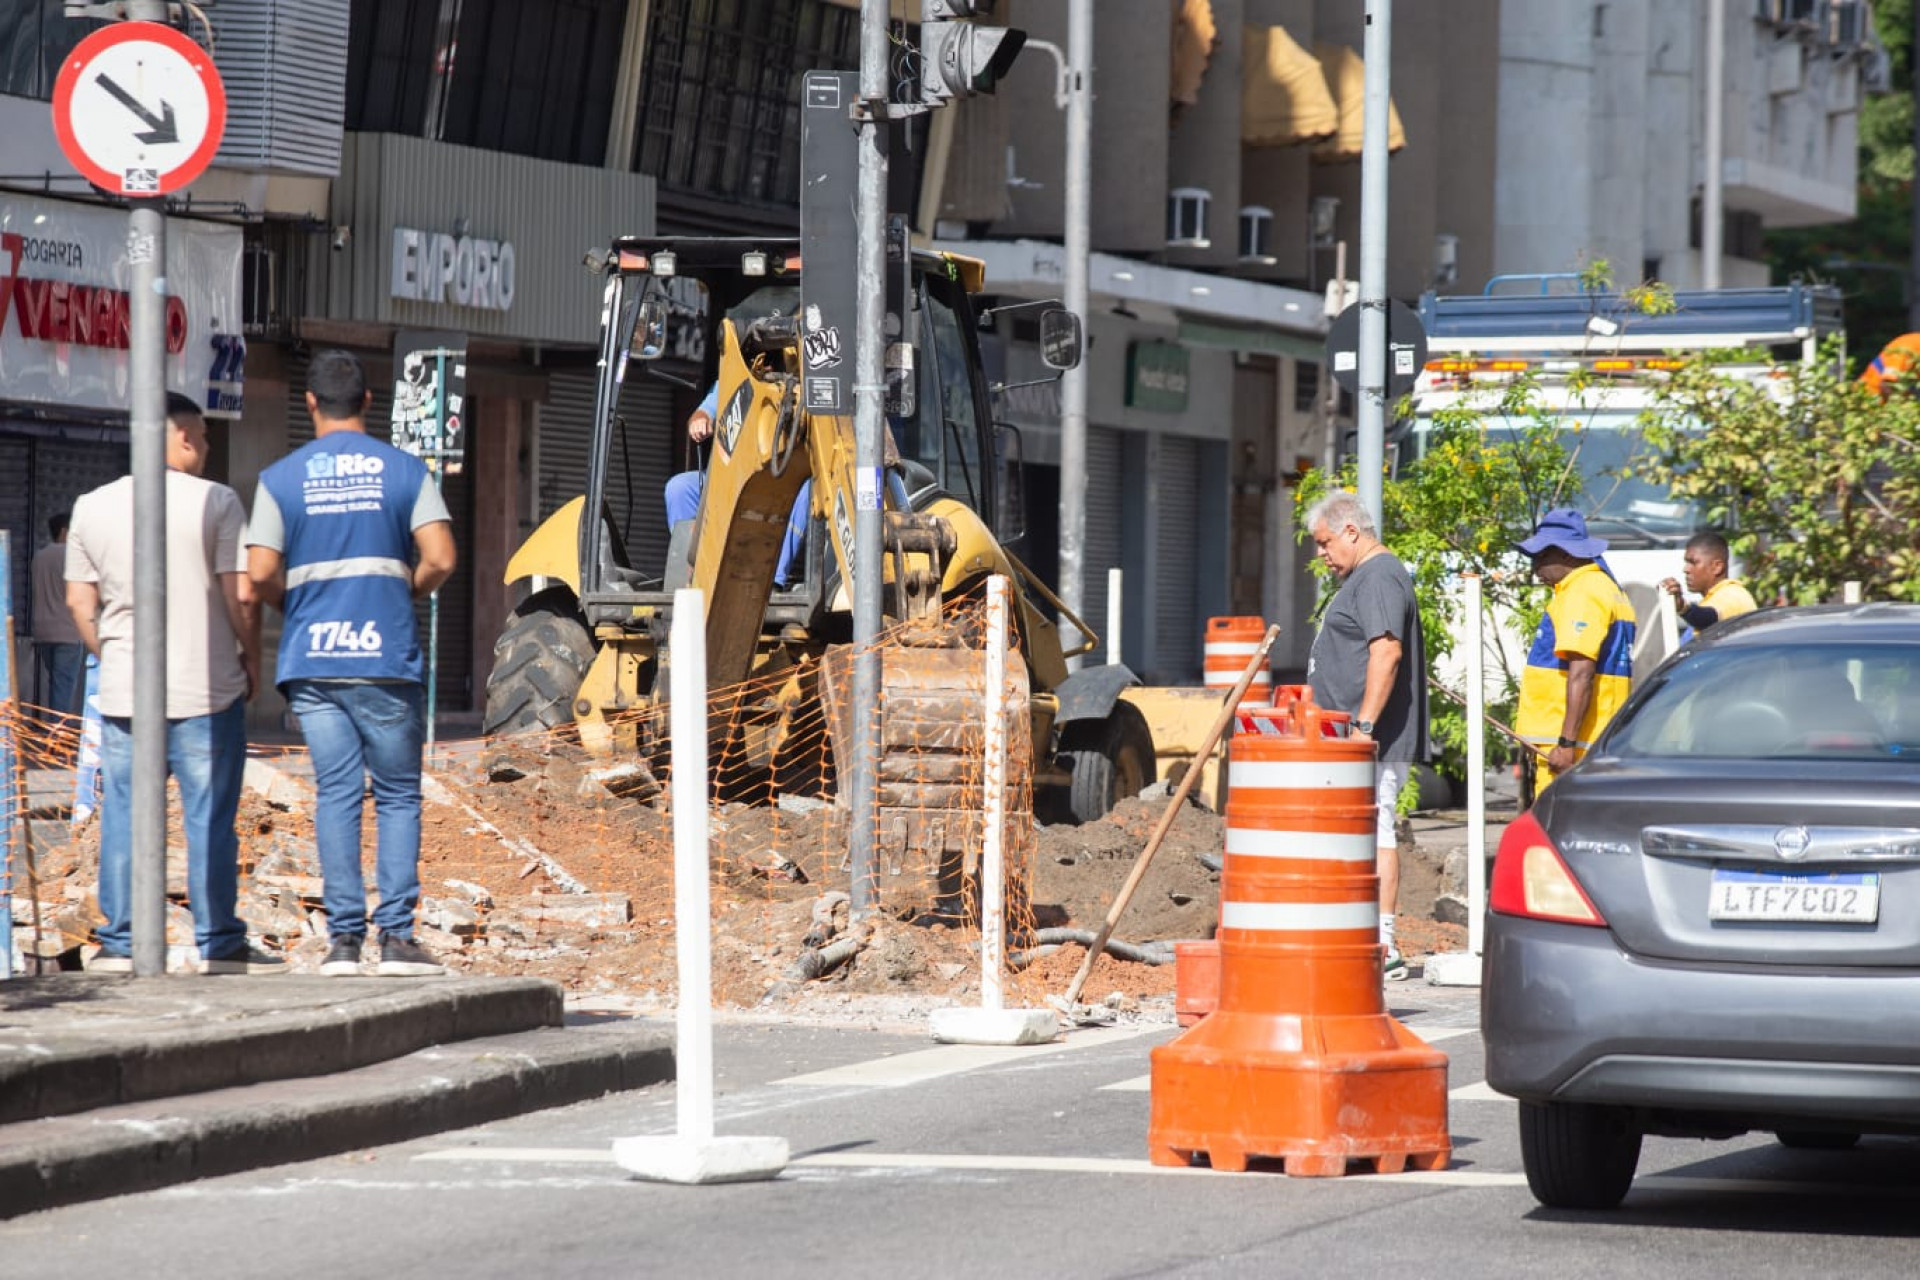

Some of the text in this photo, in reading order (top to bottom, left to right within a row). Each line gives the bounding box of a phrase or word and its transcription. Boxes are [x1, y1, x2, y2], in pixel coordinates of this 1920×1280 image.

[15, 277, 188, 355] VENANO
[336, 453, 384, 477] Rio
[308, 620, 382, 651] 1746
[1561, 840, 1632, 855] VERSA
[1723, 885, 1859, 914] LTF7C02
